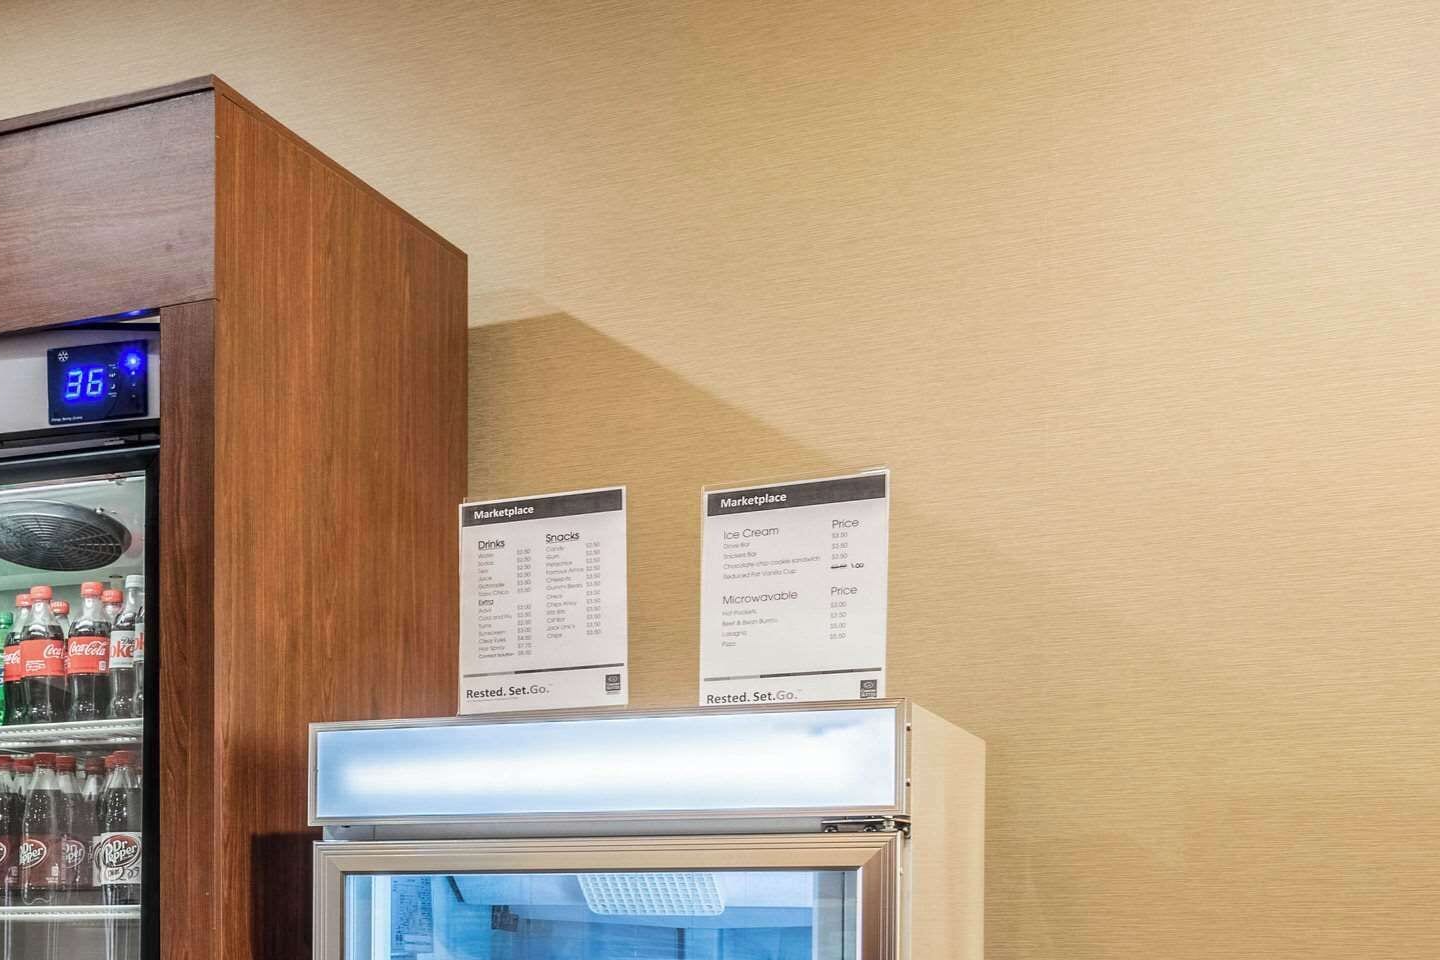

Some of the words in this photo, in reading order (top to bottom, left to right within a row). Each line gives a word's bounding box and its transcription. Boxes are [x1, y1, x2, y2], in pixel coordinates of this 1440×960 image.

[65, 368, 105, 399] 36
[720, 492, 787, 509] Marketplace
[474, 505, 535, 520] Marketplace
[832, 518, 860, 530] Price
[545, 531, 580, 543] Snacks
[723, 530, 741, 541] Ice
[742, 526, 779, 539] Cream
[478, 538, 505, 550] Drinks
[722, 590, 798, 605] Microwavable
[830, 585, 858, 597] Price
[466, 687, 507, 699] Rested.
[706, 691, 751, 704] Rested.
